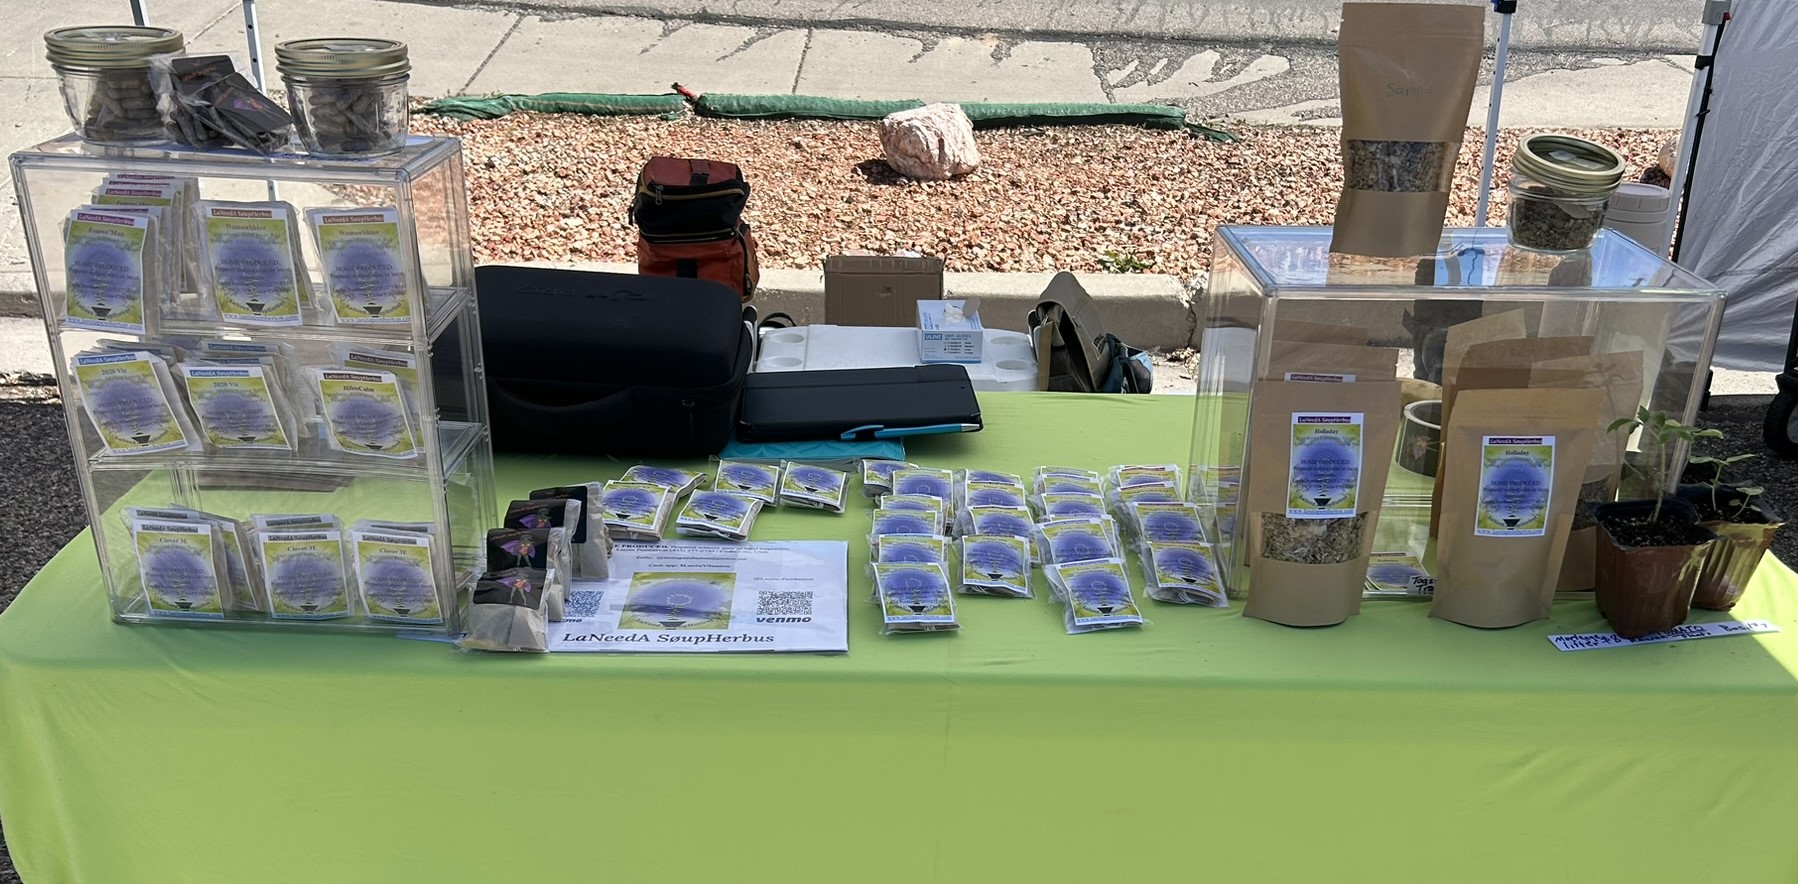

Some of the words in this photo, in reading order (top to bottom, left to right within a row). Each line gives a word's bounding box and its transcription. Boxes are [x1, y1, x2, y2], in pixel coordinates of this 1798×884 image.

[1719, 622, 1753, 632] Basil
[563, 632, 650, 644] LaNeedA
[656, 632, 775, 646] SøupHerbus
